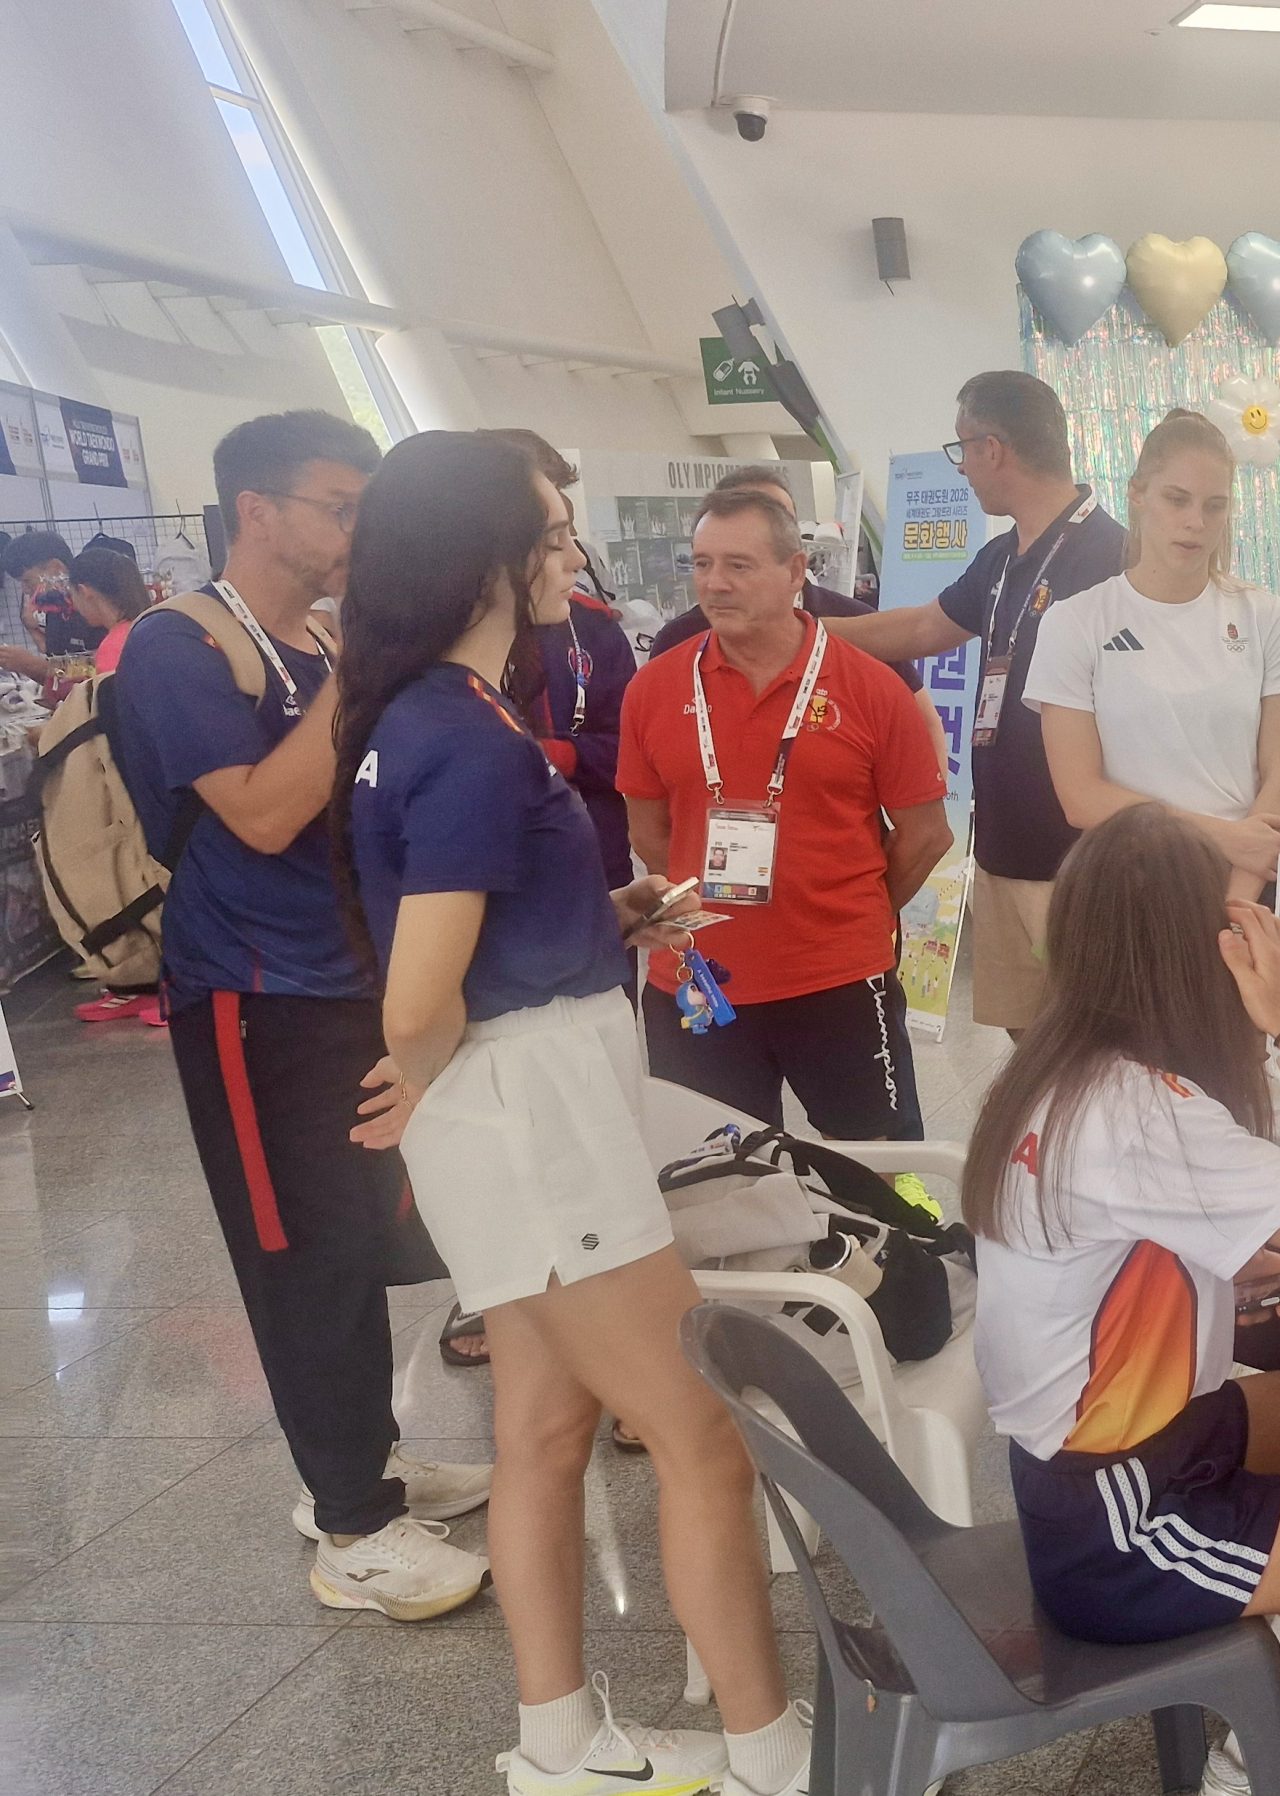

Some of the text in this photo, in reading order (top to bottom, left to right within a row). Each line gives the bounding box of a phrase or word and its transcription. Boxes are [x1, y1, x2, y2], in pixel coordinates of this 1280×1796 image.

[906, 487, 969, 505] 무주 태권도원 2026
[903, 519, 968, 550] 문화행사
